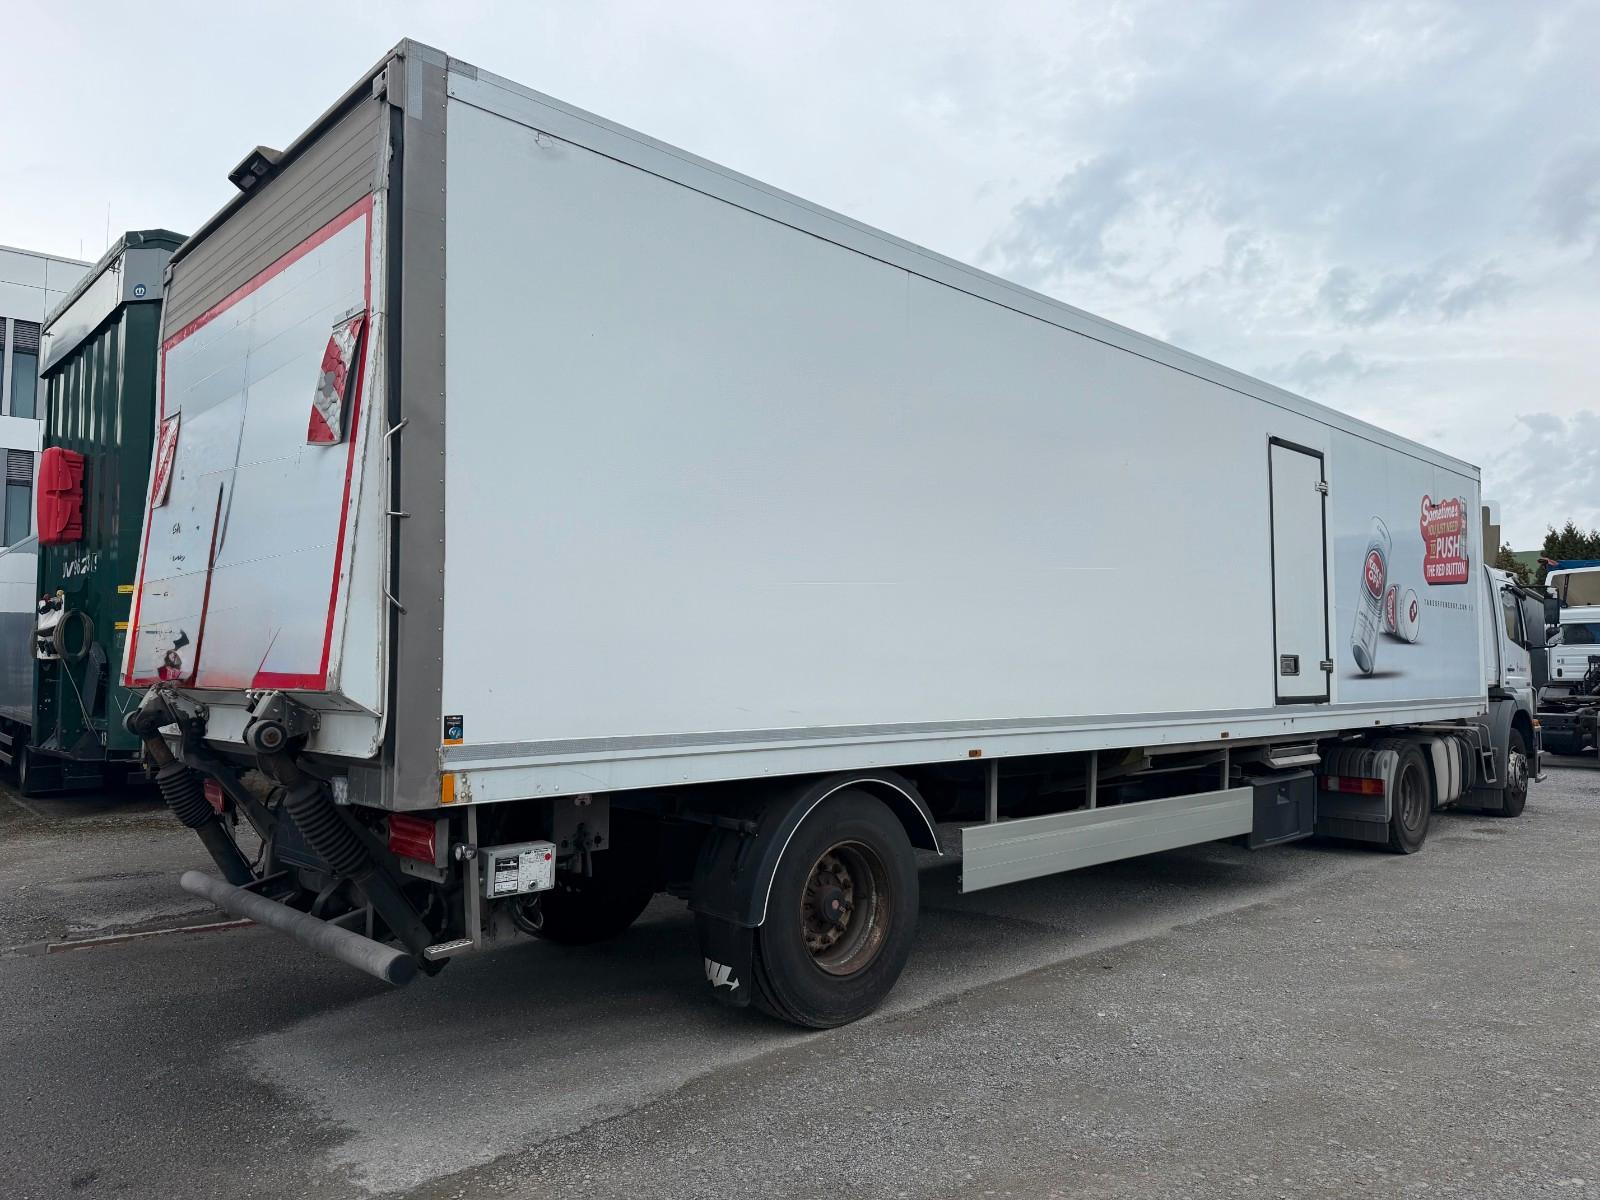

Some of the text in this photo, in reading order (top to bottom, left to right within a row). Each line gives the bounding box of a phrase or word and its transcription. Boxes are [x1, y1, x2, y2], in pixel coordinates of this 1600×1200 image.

[1436, 535, 1460, 559] PUSH
[1426, 561, 1466, 577] THE RED BUTTON
